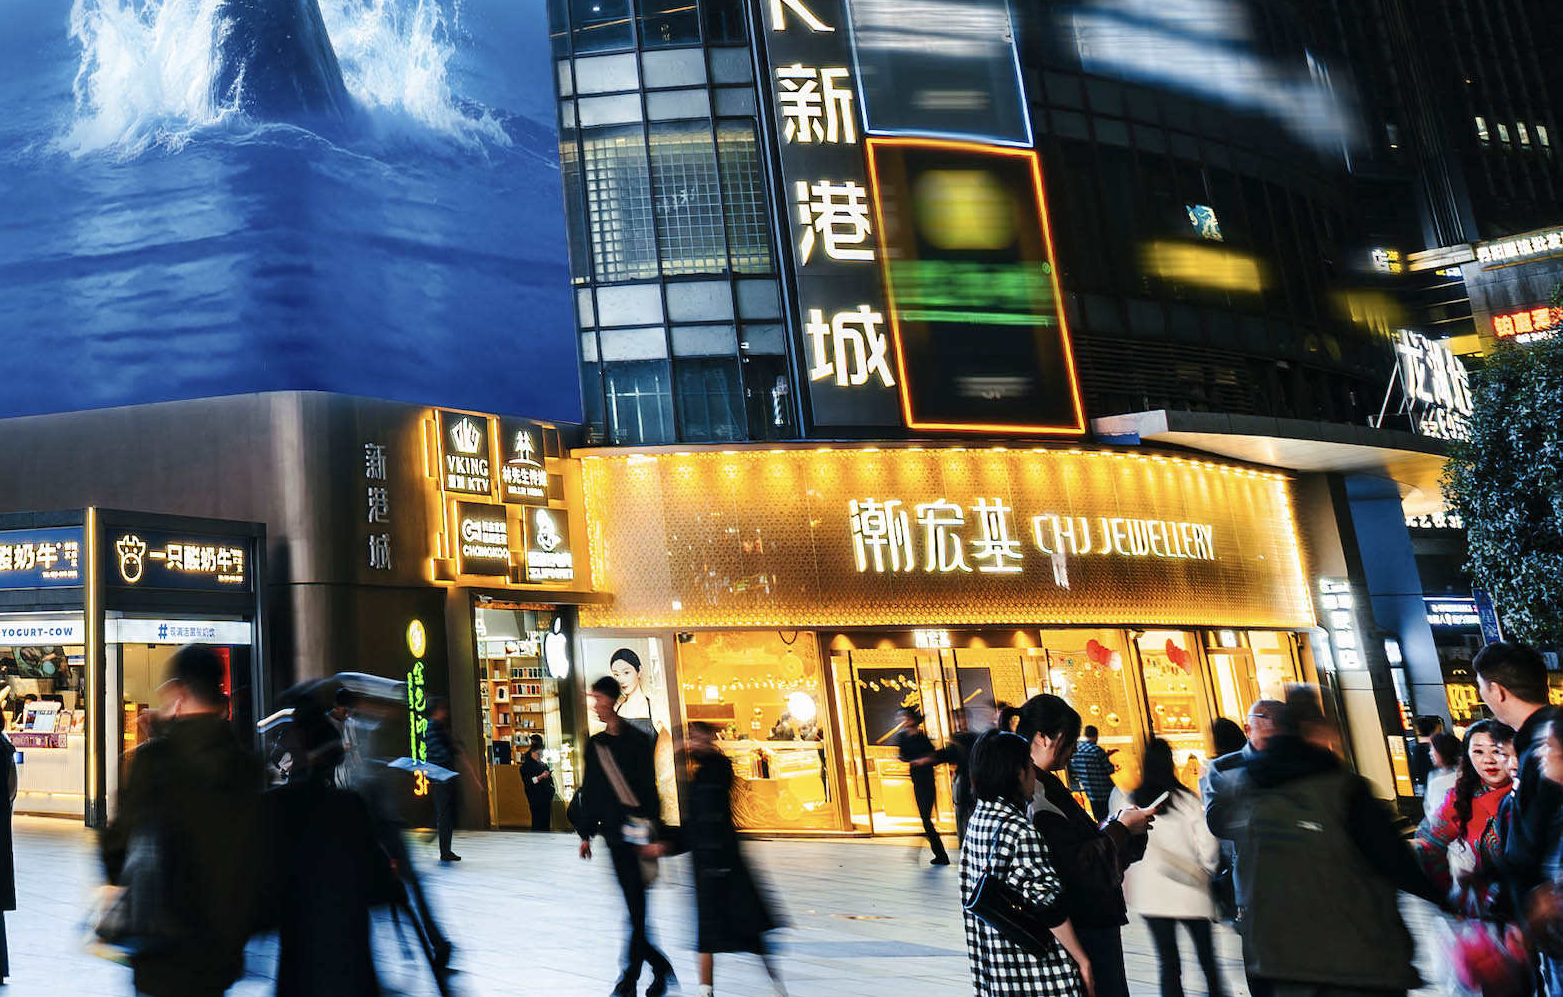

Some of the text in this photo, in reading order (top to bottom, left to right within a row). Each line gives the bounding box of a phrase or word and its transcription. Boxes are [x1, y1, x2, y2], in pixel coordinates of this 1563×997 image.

[775, 64, 897, 389] 新港城
[364, 443, 393, 571] 新港城
[468, 478, 490, 491] KTV
[149, 544, 232, 572] 一只酸奶牛
[848, 498, 1024, 574] 潮宏基
[1098, 517, 1215, 560] JEWELLERY
